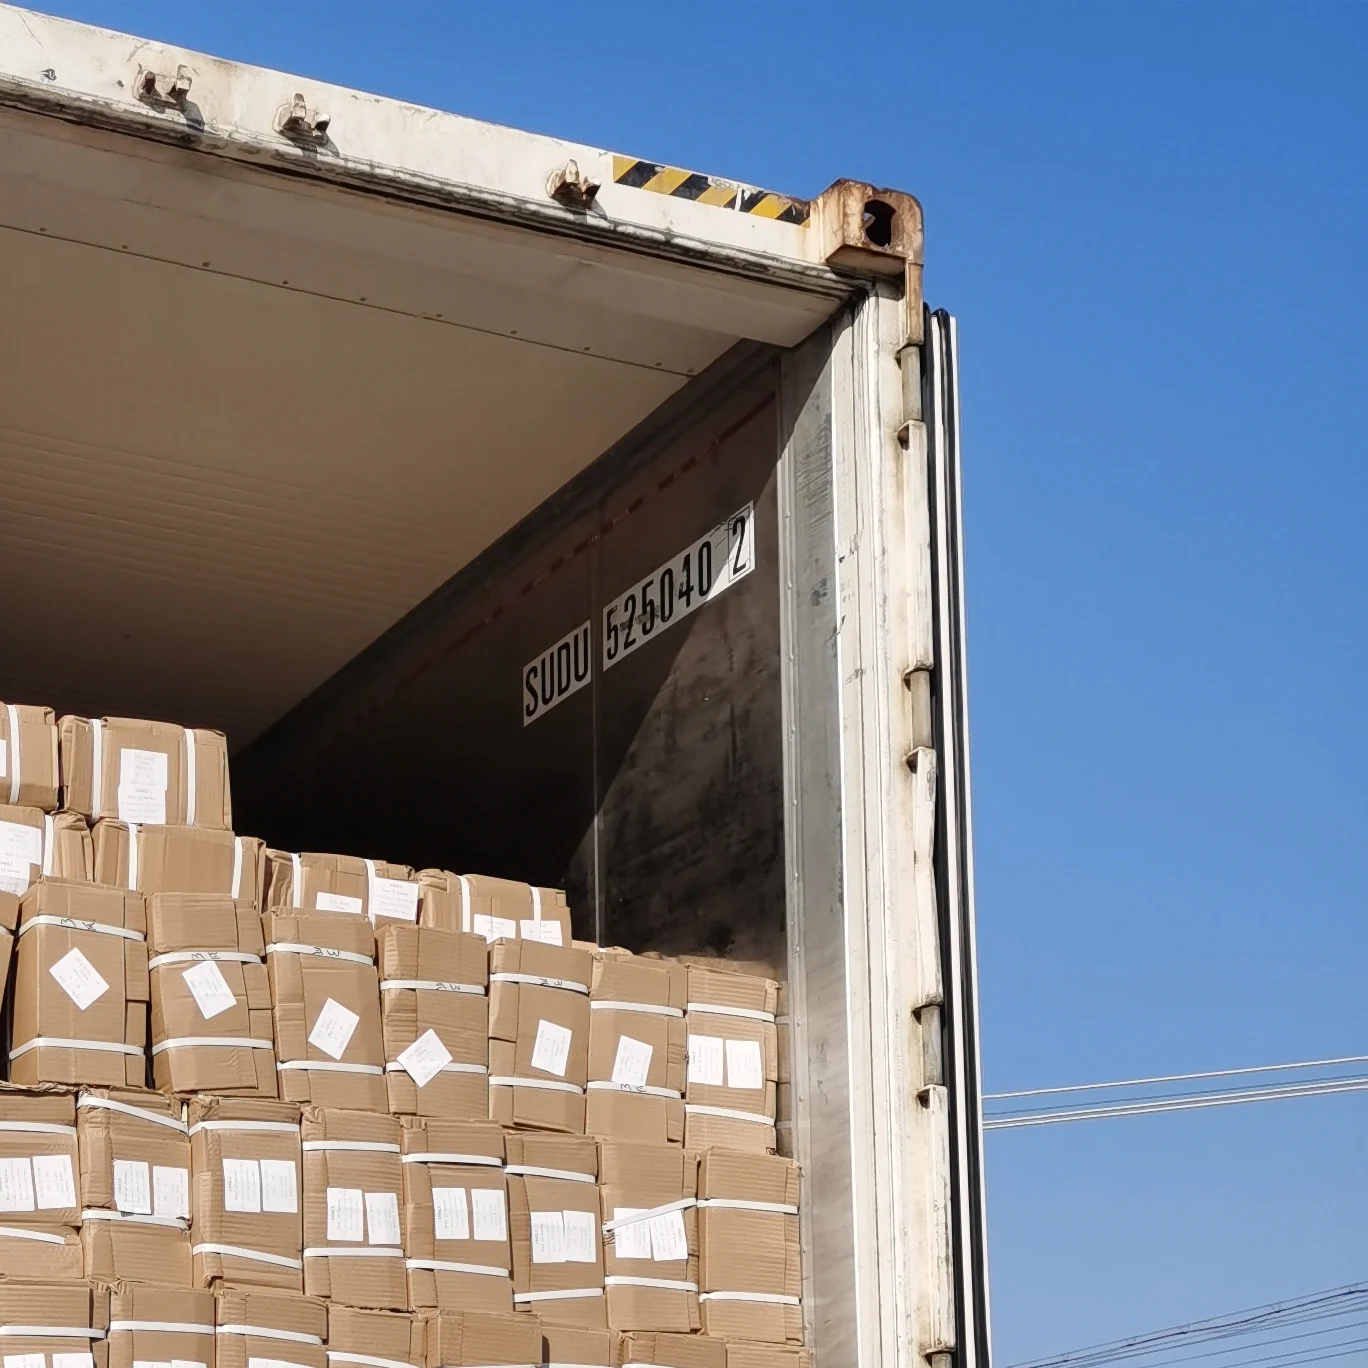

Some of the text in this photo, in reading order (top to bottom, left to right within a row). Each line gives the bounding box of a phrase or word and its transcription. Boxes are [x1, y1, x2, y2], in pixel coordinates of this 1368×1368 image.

[525, 514, 747, 718] SUDU 525040 2
